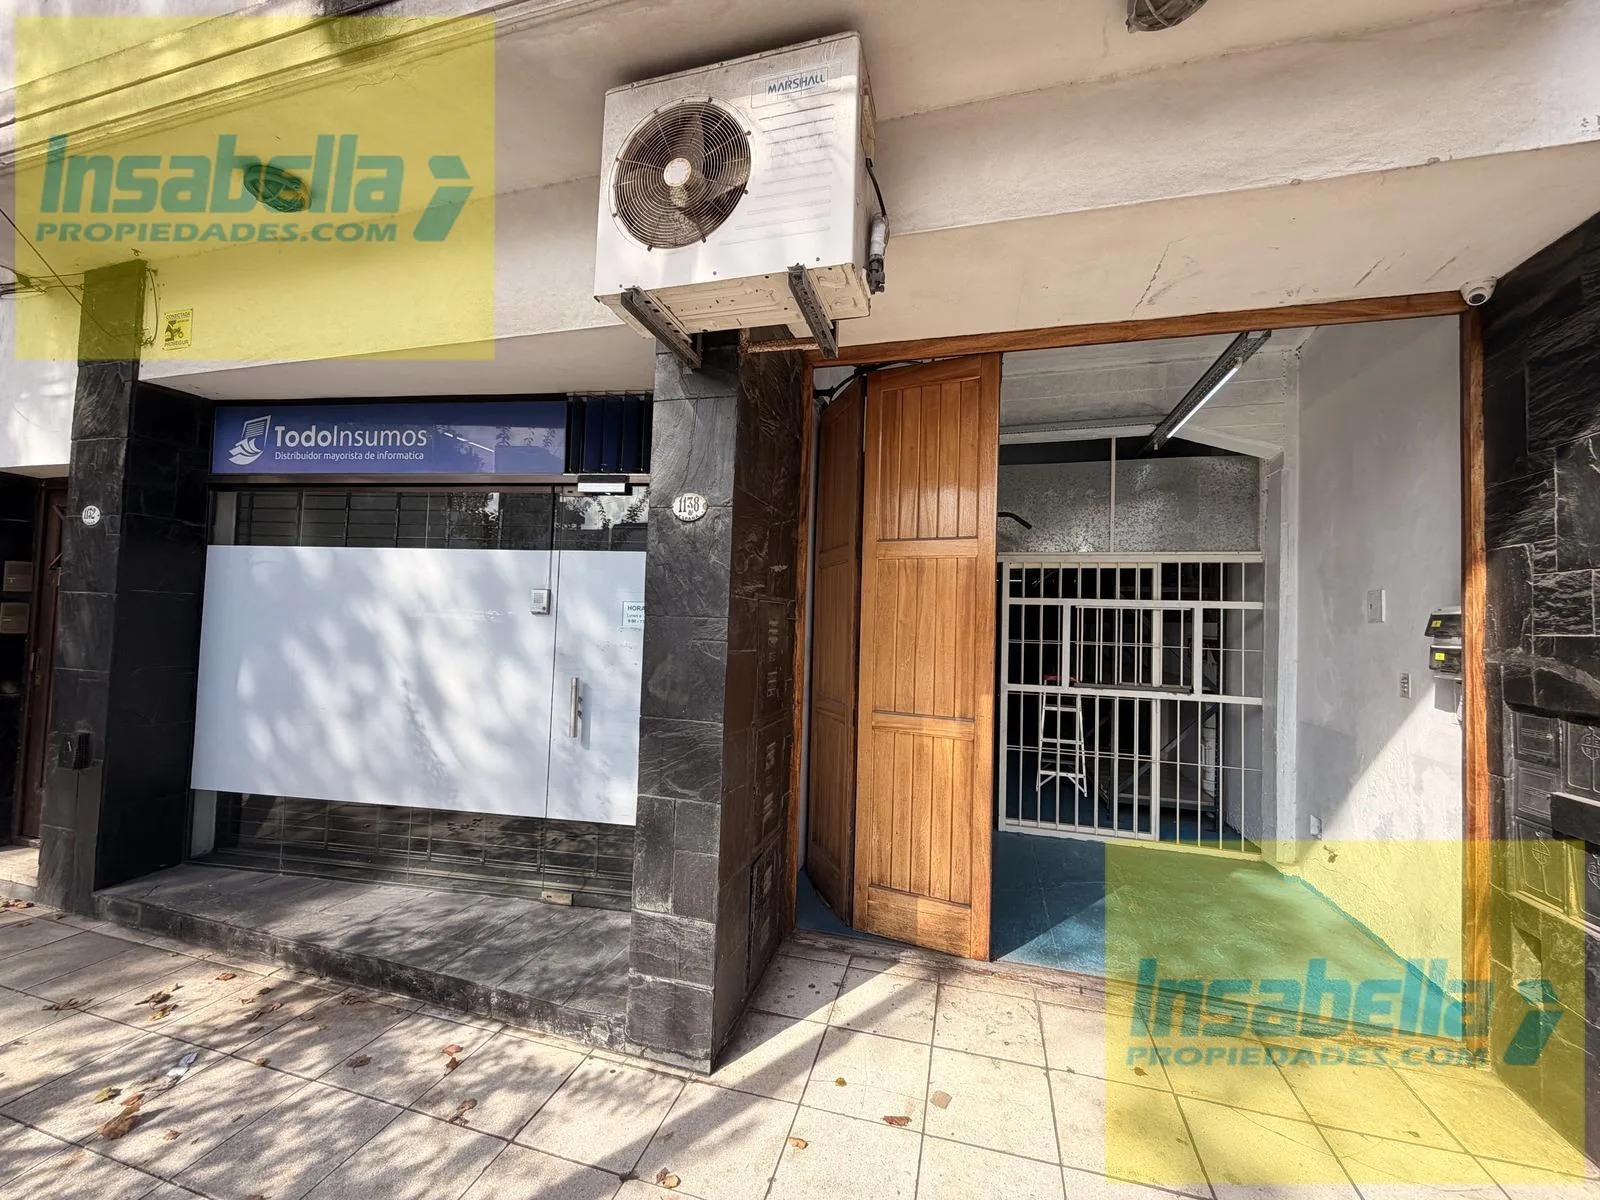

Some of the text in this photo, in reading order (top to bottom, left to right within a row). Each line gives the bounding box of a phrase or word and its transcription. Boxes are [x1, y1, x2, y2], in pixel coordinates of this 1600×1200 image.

[767, 74, 825, 94] MARSHALL
[274, 425, 427, 447] TodoInsumos
[275, 451, 424, 462] Distribuidor mayorista de informatica
[678, 496, 700, 512] 1138
